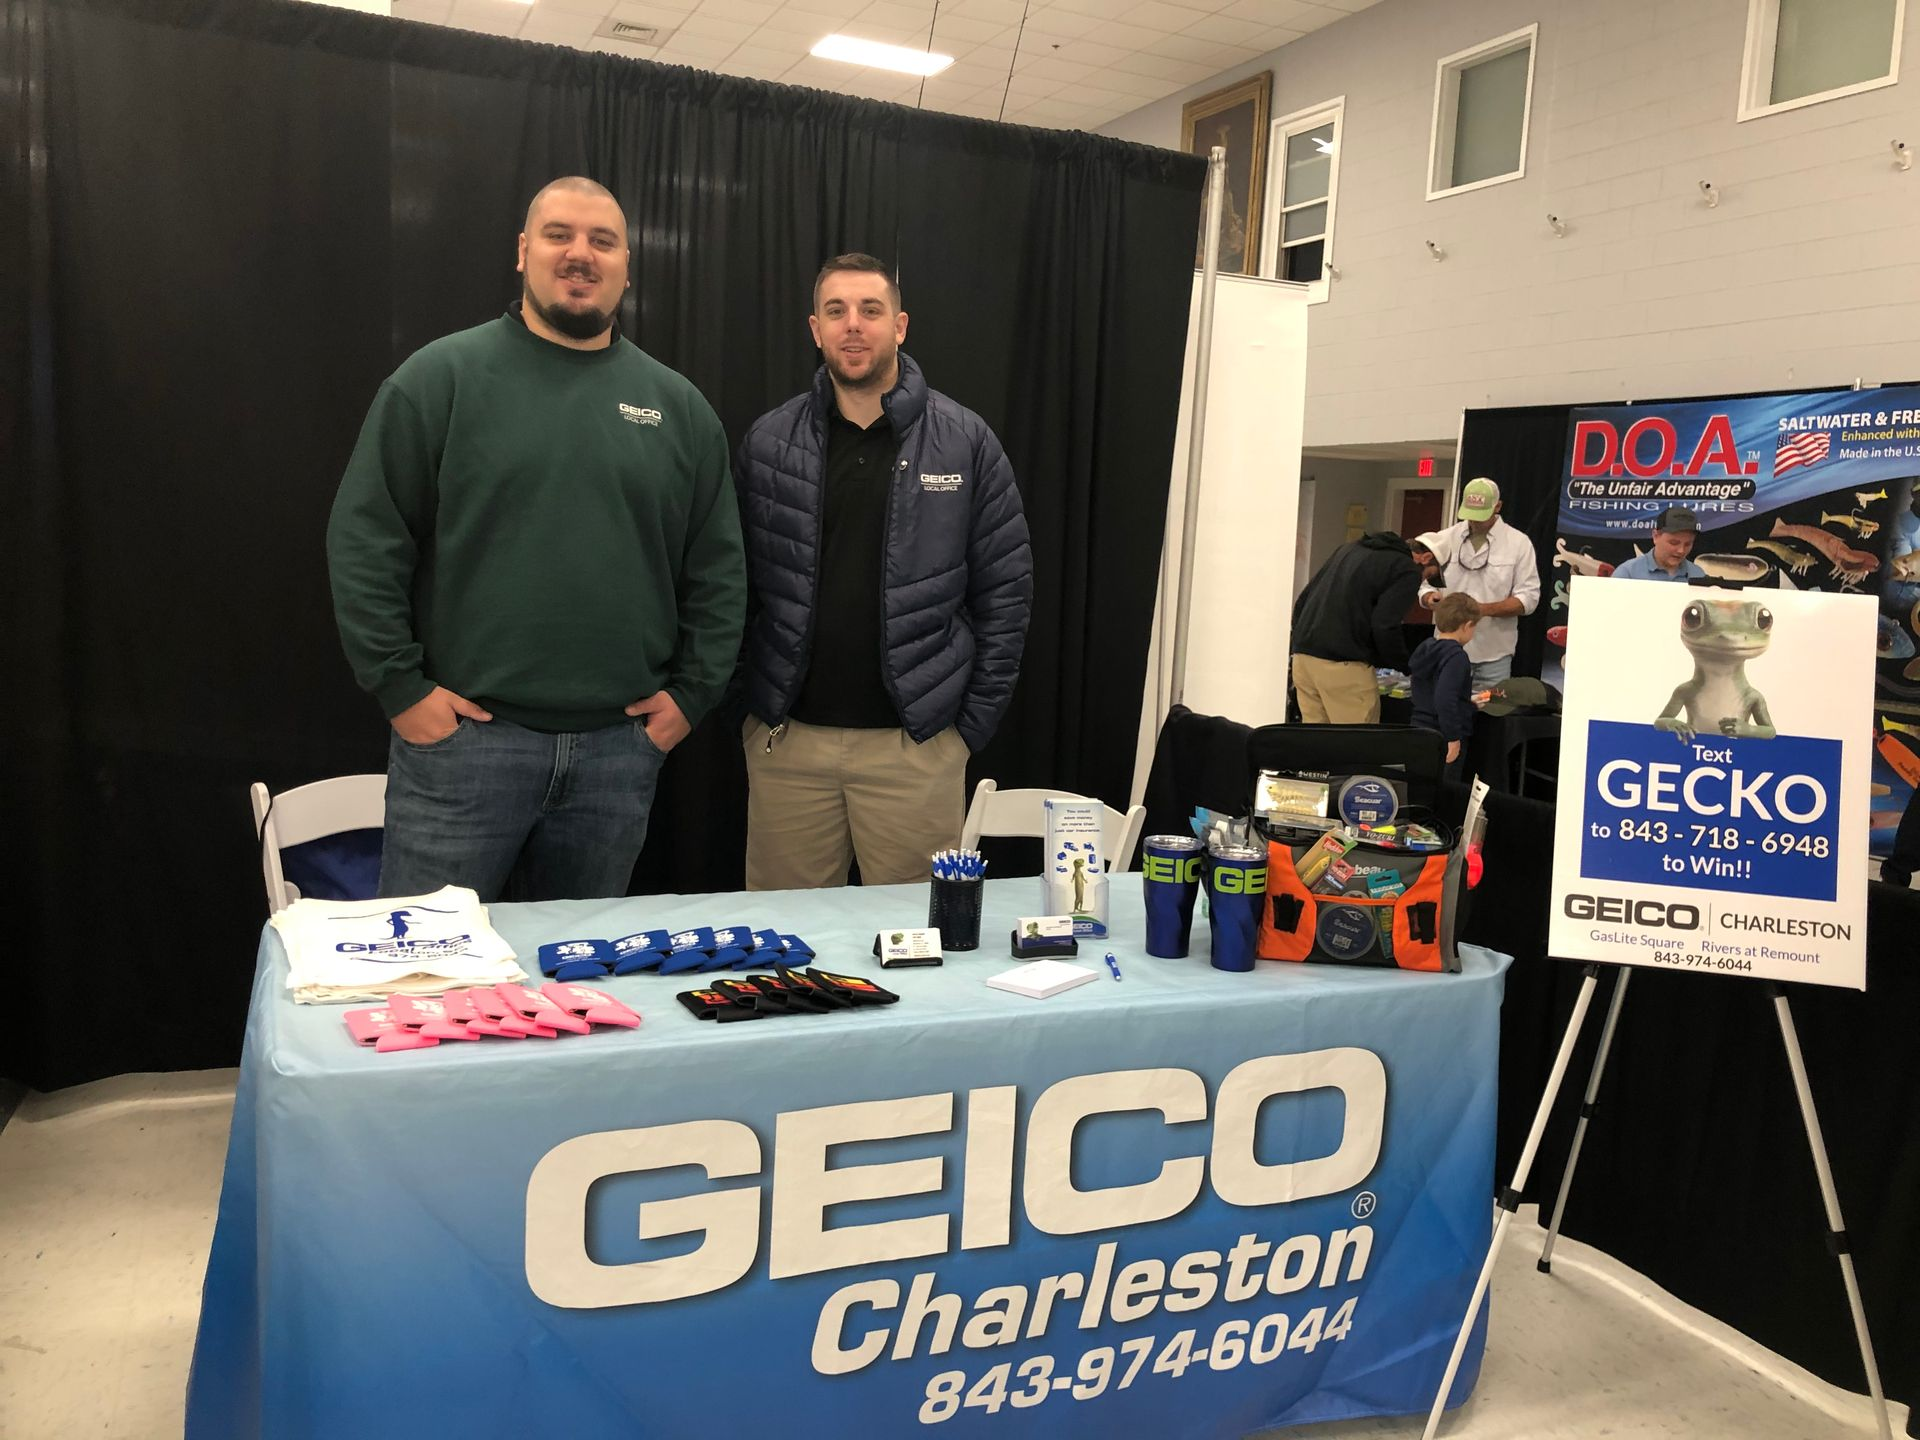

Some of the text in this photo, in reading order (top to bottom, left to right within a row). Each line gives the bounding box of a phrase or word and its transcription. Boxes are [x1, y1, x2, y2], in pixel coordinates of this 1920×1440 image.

[619, 403, 662, 420] GEICO
[624, 415, 658, 427] LOCAL OFFICE
[1779, 410, 1920, 431] SALTWATER & FRE
[1842, 428, 1920, 442] Enhanced with
[1571, 414, 1761, 478] D.O.A.
[1840, 448, 1868, 459] Made
[1871, 447, 1881, 458] in
[1884, 447, 1902, 457] the
[921, 473, 962, 483] GEICO
[1419, 459, 1433, 476] EXIT
[1574, 481, 1750, 500] "The Unfair Advantage"
[1569, 501, 1755, 513] FISHING URES
[1692, 744, 1733, 763] Text
[1597, 759, 1828, 824] GECKO
[1591, 822, 1610, 838] to
[1619, 819, 1668, 844] 843
[1691, 825, 1739, 850] 718
[1761, 831, 1829, 858] 6948
[1662, 853, 1751, 879] to Win!!
[1564, 893, 1852, 941] GEICO CHARLESTON
[336, 934, 470, 952] GEICO
[1590, 929, 1821, 964] GasLite Square Rivers at Remount
[1654, 951, 1753, 972] 843-974-6044
[525, 1047, 1387, 1310] GEICO
[810, 1225, 1375, 1376] Charleston
[917, 1297, 1358, 1425] 843-974-6044
